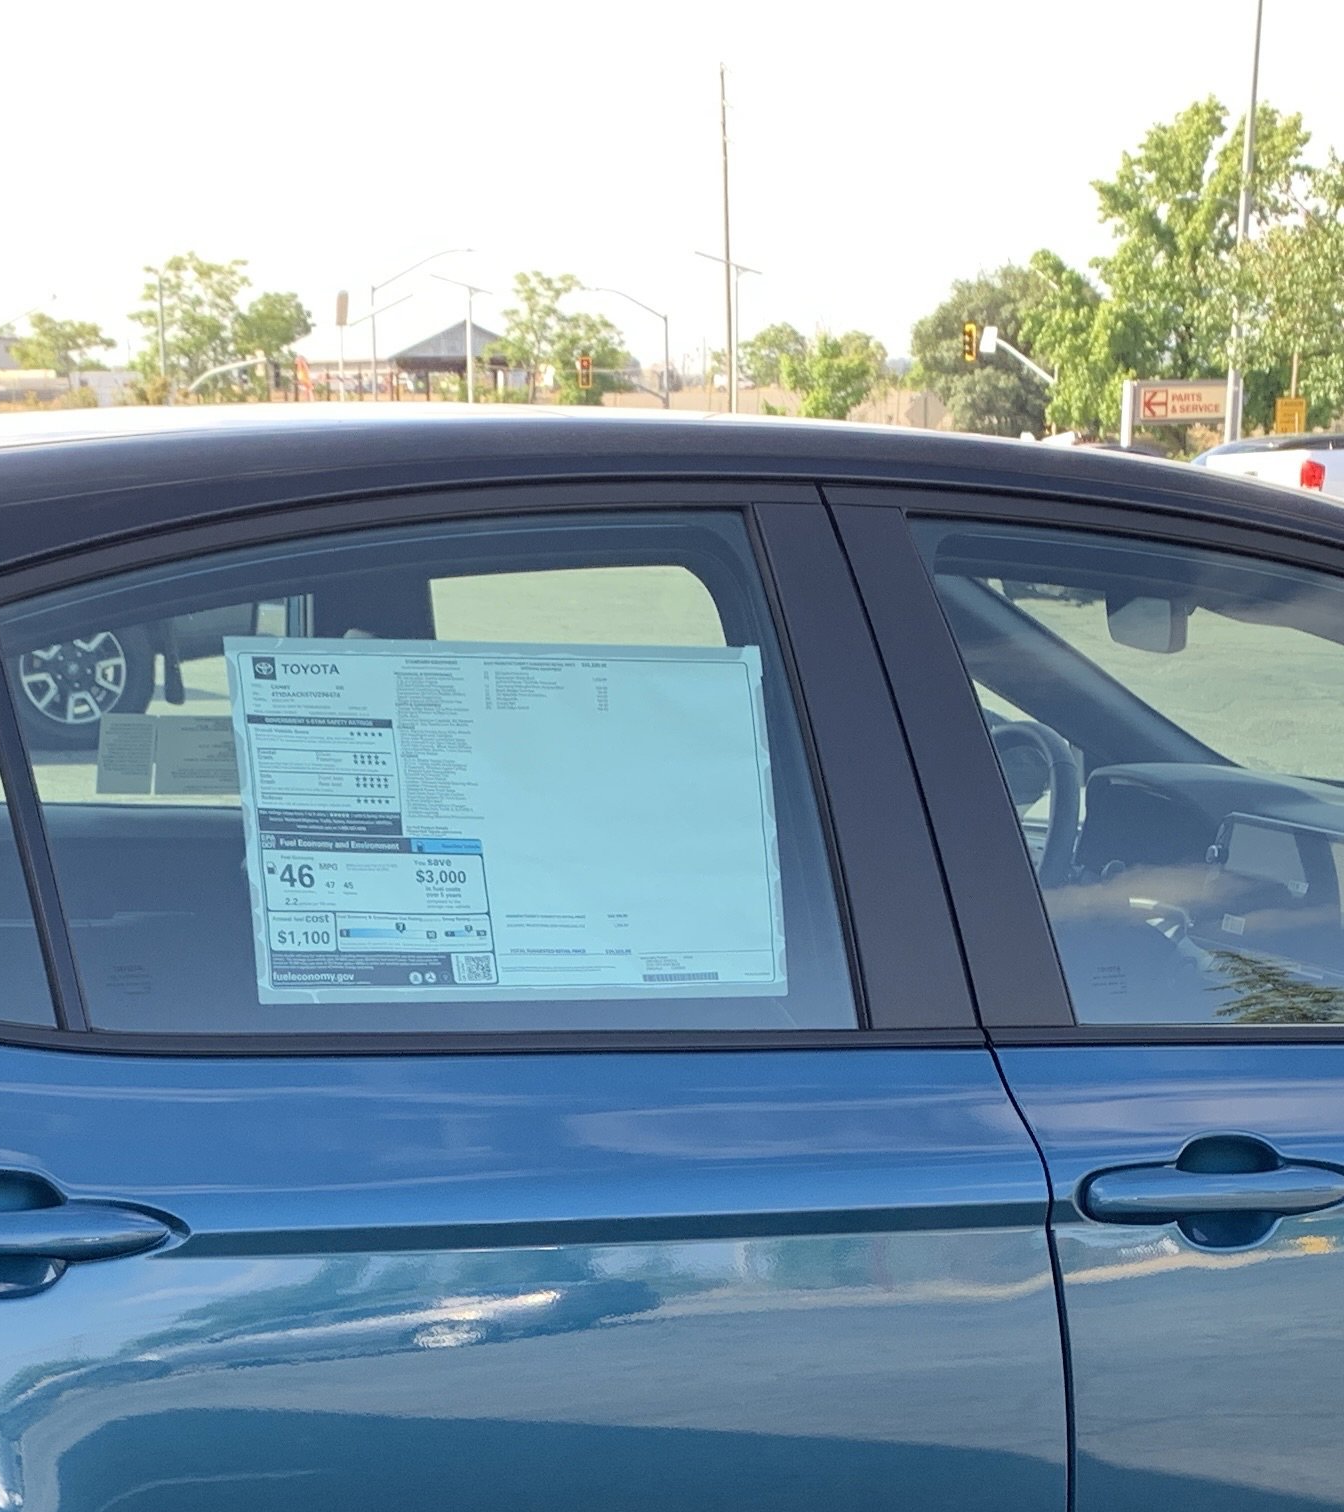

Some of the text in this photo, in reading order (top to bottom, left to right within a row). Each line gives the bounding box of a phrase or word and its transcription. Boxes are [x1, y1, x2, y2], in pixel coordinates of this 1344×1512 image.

[1171, 392, 1202, 402] PARTS
[1171, 403, 1220, 413] & SERVICE
[281, 663, 340, 675] TOYOTA
[280, 838, 399, 850] Fuel Economy and Environment
[427, 858, 452, 867] save
[280, 863, 315, 889] 46
[319, 863, 338, 871] MPG
[416, 870, 467, 885] $3,000
[325, 881, 354, 890] 47 45
[285, 897, 299, 905] 2.2
[305, 913, 330, 924] cost
[277, 929, 331, 947] $1,100
[273, 971, 355, 983] fueleconomy.gov
